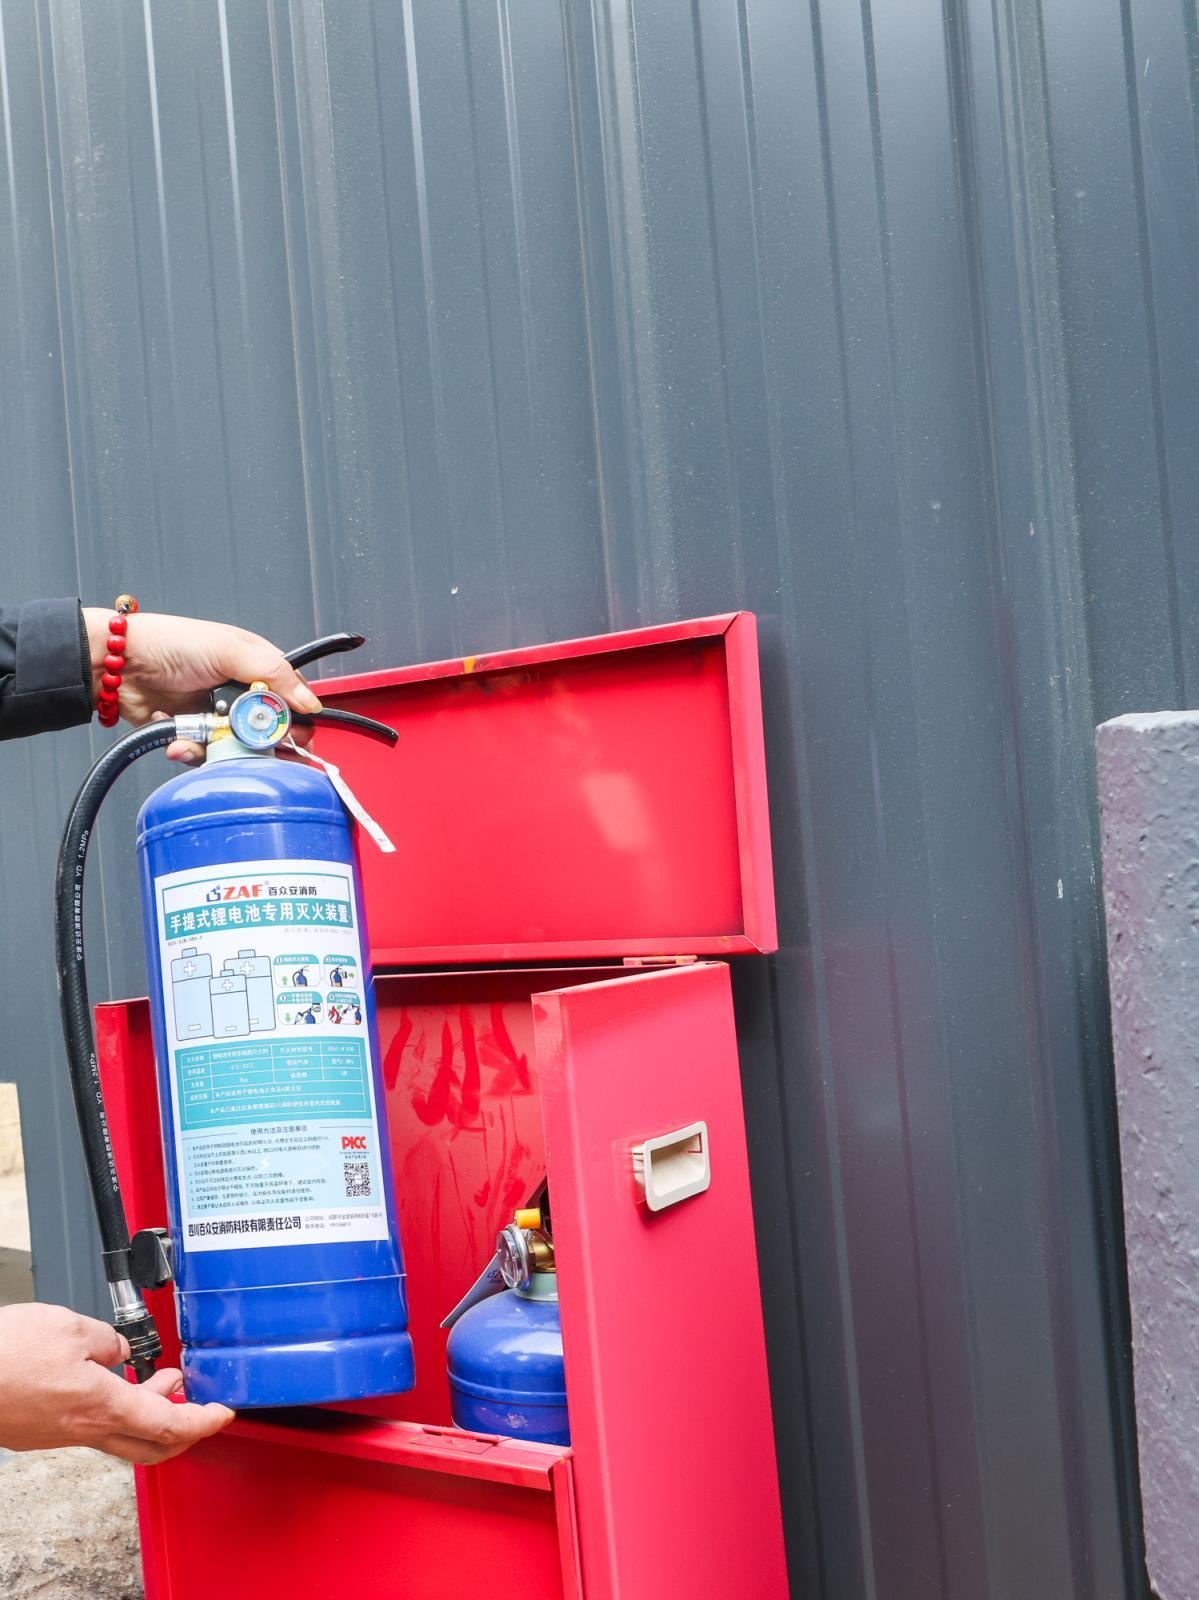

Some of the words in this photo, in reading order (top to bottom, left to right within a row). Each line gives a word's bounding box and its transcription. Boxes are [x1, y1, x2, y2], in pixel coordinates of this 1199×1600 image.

[78, 830, 89, 859] 1.2MPa
[75, 865, 83, 877] YD
[268, 886, 317, 896] 百众安消防
[170, 902, 349, 934] 手提式锂电池专用灭火装置
[90, 1053, 100, 1085] 1.2MPa
[95, 1091, 103, 1105] YD
[188, 1216, 301, 1236] 四川百众安消防科技有限责任公司
